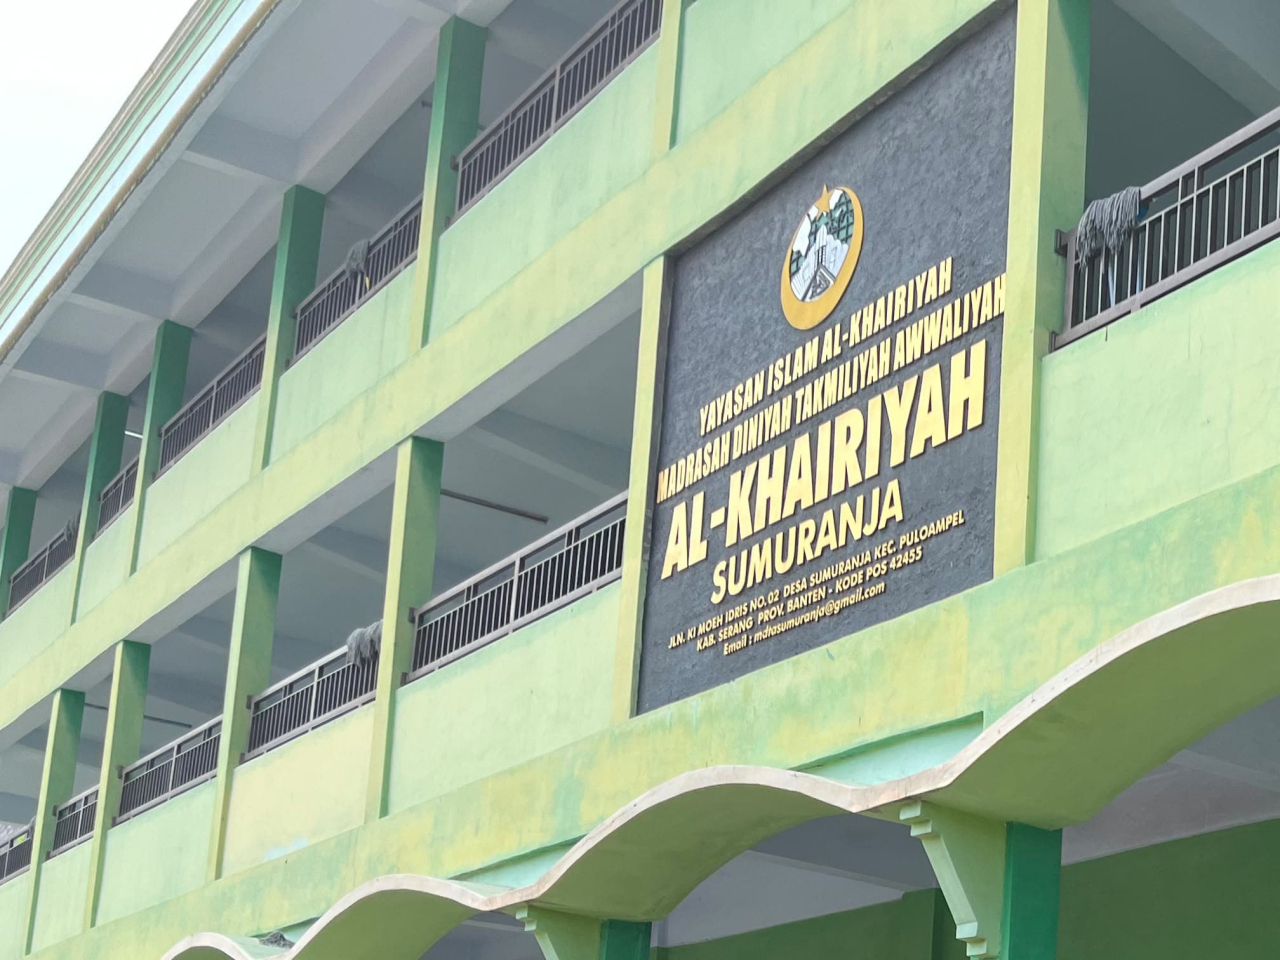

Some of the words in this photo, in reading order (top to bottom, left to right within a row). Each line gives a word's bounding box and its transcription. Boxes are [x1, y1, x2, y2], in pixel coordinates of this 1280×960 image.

[656, 430, 731, 504] MADRASAH
[732, 394, 793, 460] DINIYAH
[795, 336, 892, 425] TAKMILIYAH
[893, 272, 1006, 372] AWWALIYAH
[700, 370, 765, 437] YAYASAN
[767, 336, 820, 396] ISLAM
[821, 256, 953, 364] AL-KHAIRIYAH
[660, 339, 987, 580] AL-KHAIRIYAH
[668, 631, 686, 649] JLN.
[687, 627, 697, 641] KI
[698, 614, 724, 636] MOEH
[725, 602, 748, 624] IDRIS
[783, 577, 808, 598] DESA
[810, 550, 871, 587] SUMURANJA
[874, 540, 896, 560] KEC.
[899, 509, 965, 548] PULOAMPEL
[697, 634, 716, 652] KAB.
[718, 616, 754, 642] SERANG
[758, 602, 785, 625] PROV.
[787, 585, 826, 613] BANTEN
[835, 571, 864, 594] KODE
[866, 561, 888, 581] POS
[889, 546, 923, 570] 42455
[710, 478, 904, 605] SUMURANJA
[724, 633, 747, 656] Email
[754, 581, 886, 643] mdtasumuranja@gmail.com
